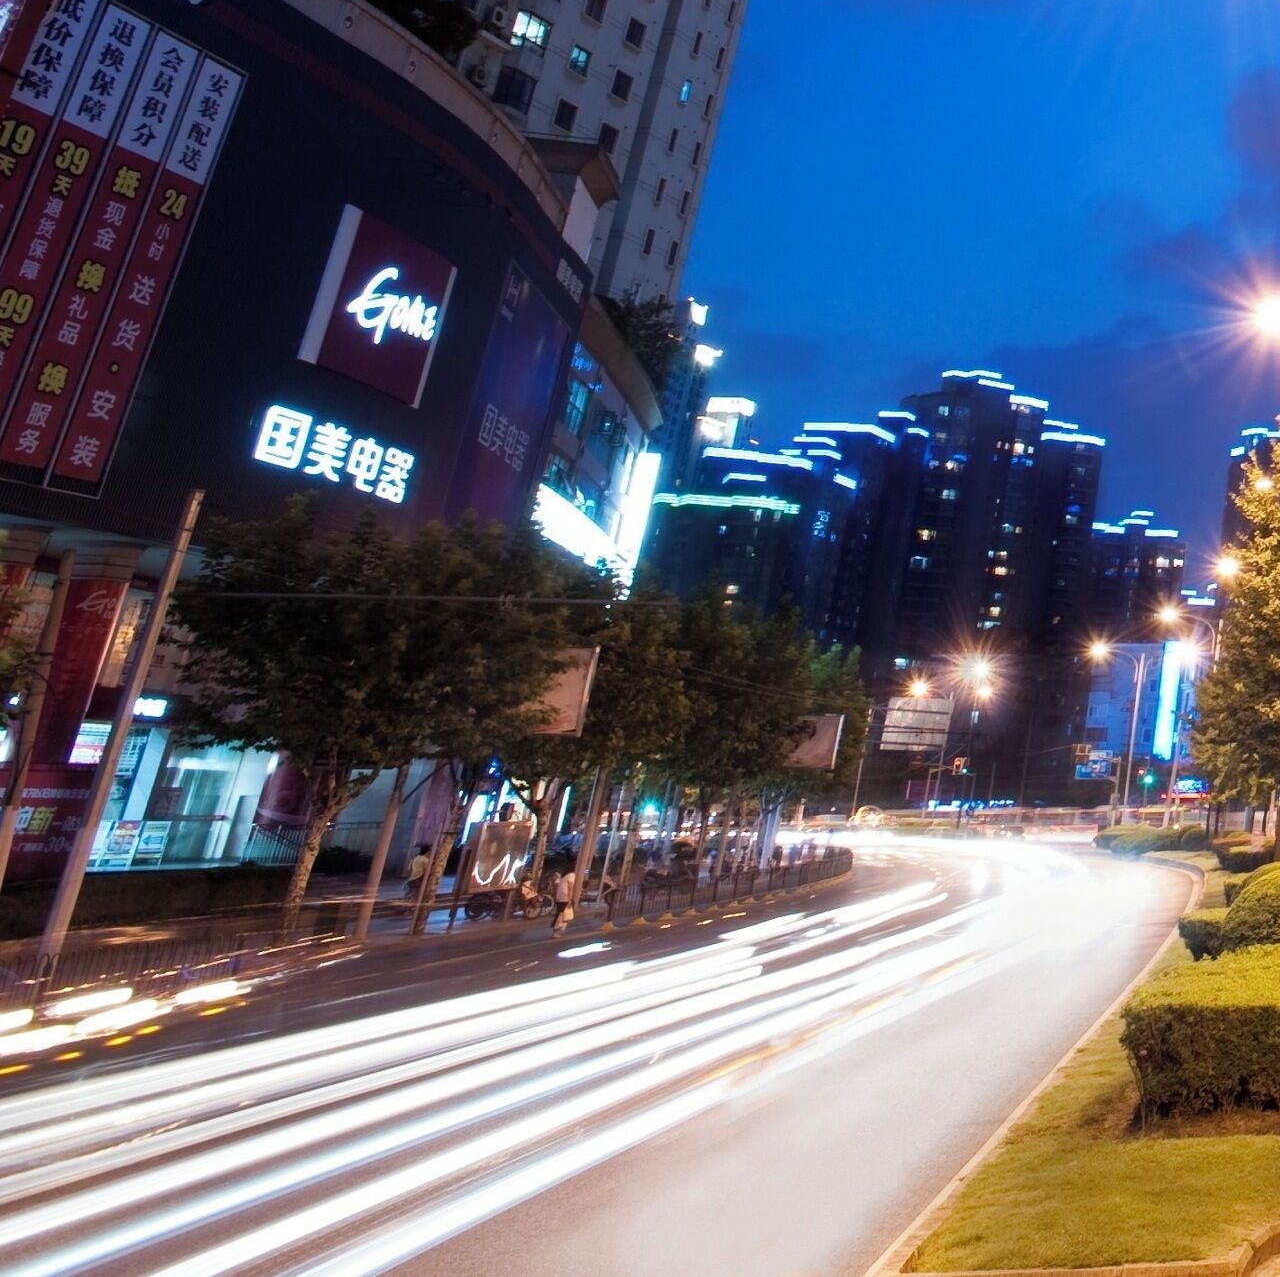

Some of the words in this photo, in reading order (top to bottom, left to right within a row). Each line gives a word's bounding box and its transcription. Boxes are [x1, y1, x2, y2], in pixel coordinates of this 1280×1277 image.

[76, 17, 138, 124] 退换保障
[129, 45, 186, 149] 会员积分
[178, 72, 231, 172] 安装配送
[254, 404, 415, 504] 国美电器
[478, 402, 531, 473] 国美电器
